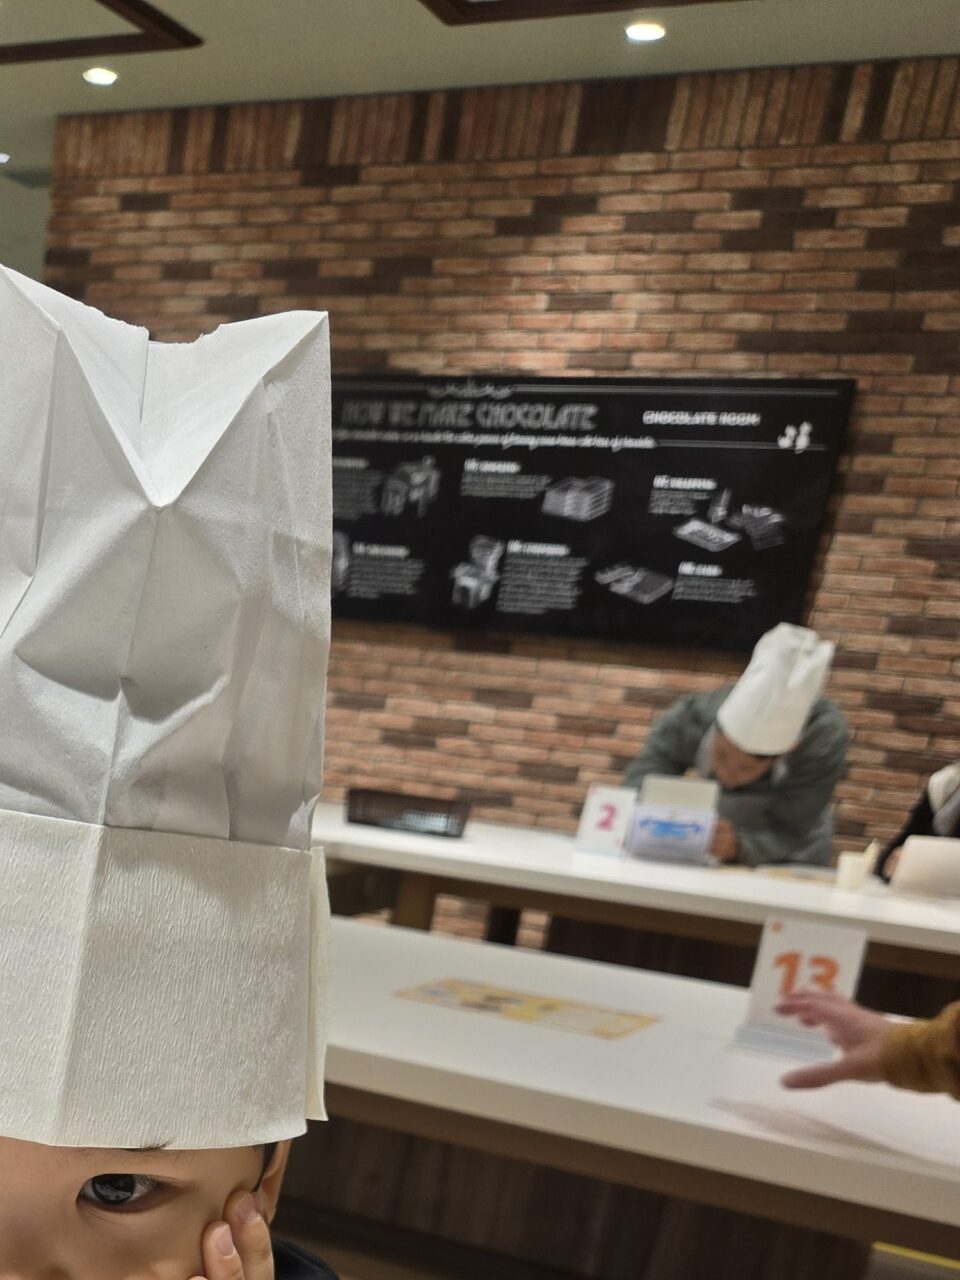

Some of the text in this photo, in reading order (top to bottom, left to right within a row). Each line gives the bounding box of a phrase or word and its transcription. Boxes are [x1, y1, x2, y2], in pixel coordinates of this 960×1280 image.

[475, 402, 599, 432] CHOCOLATE
[642, 410, 718, 426] CHOCOLATE
[596, 802, 618, 831] 2
